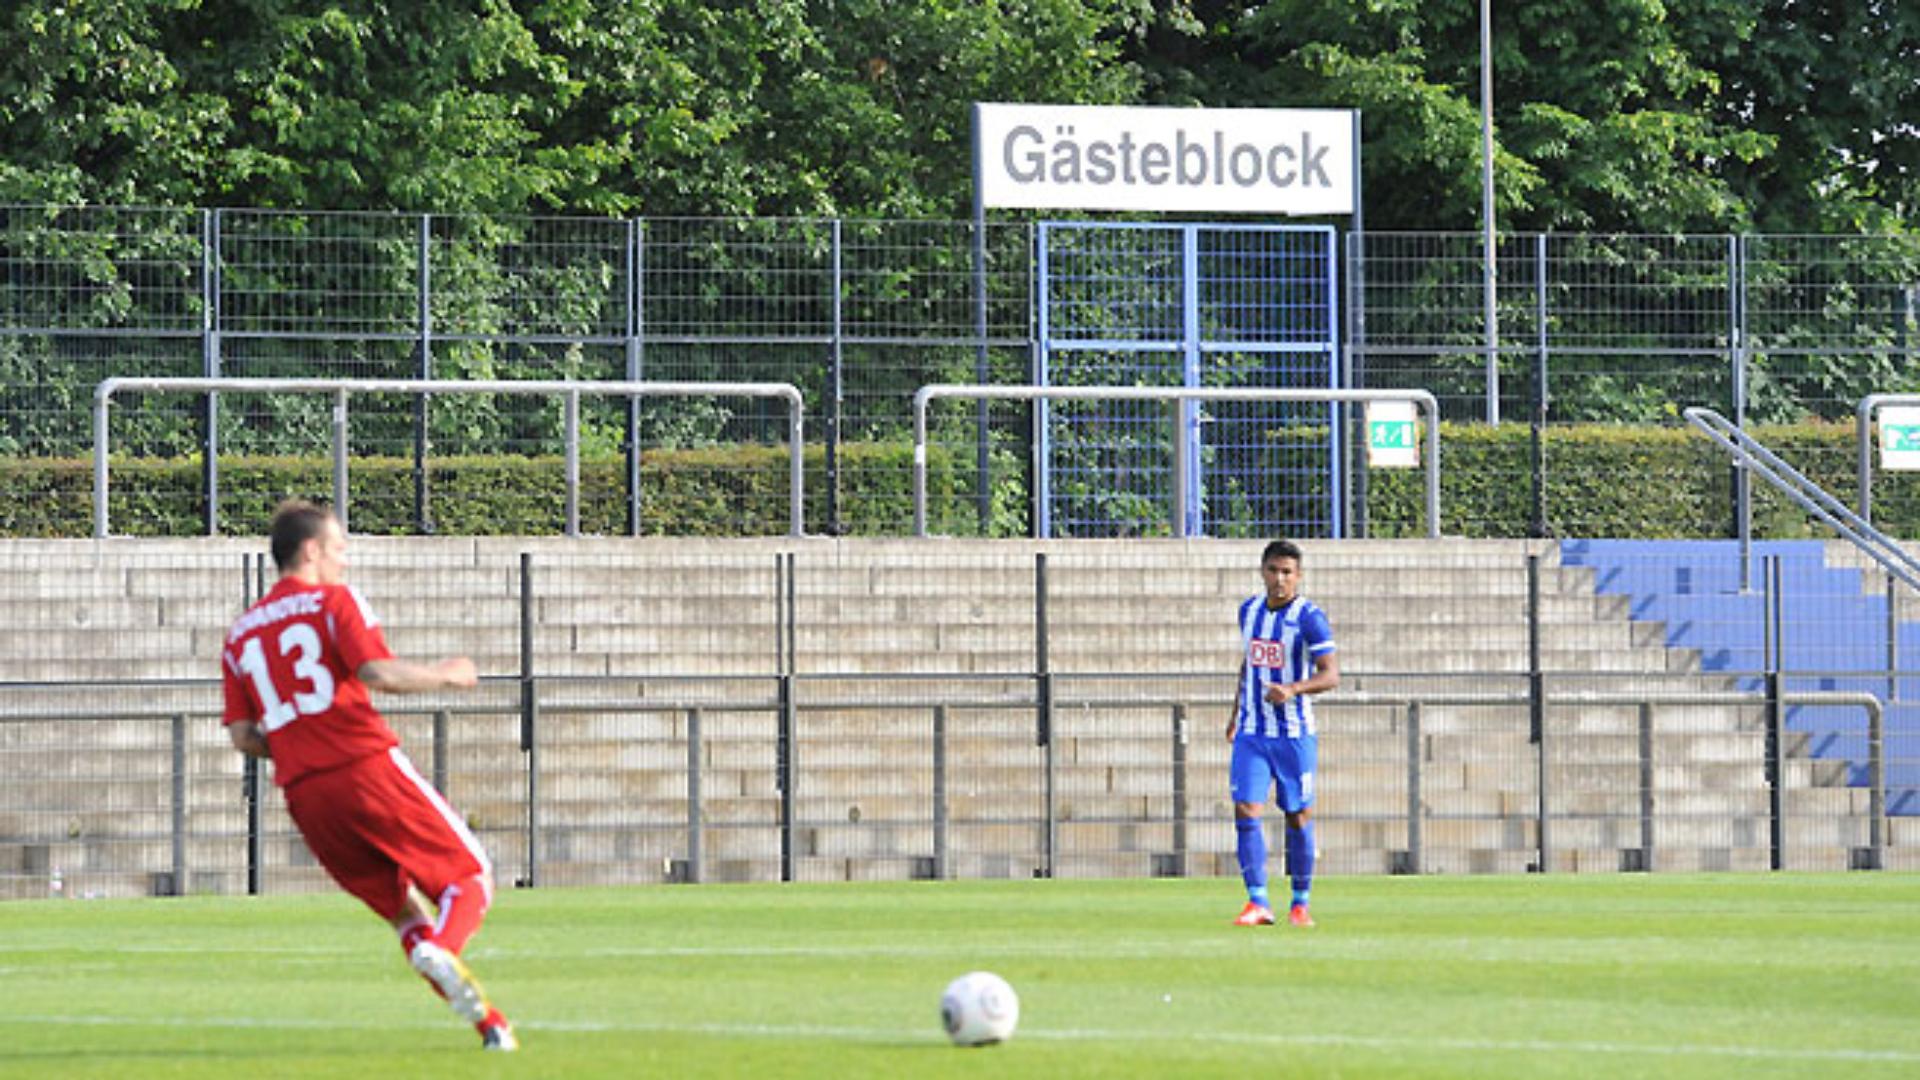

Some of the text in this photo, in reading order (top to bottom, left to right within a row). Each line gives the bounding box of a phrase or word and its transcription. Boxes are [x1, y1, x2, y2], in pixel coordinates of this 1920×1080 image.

[1002, 124, 1333, 188] Gästeblock
[239, 622, 335, 732] 13
[1250, 642, 1282, 663] DB
